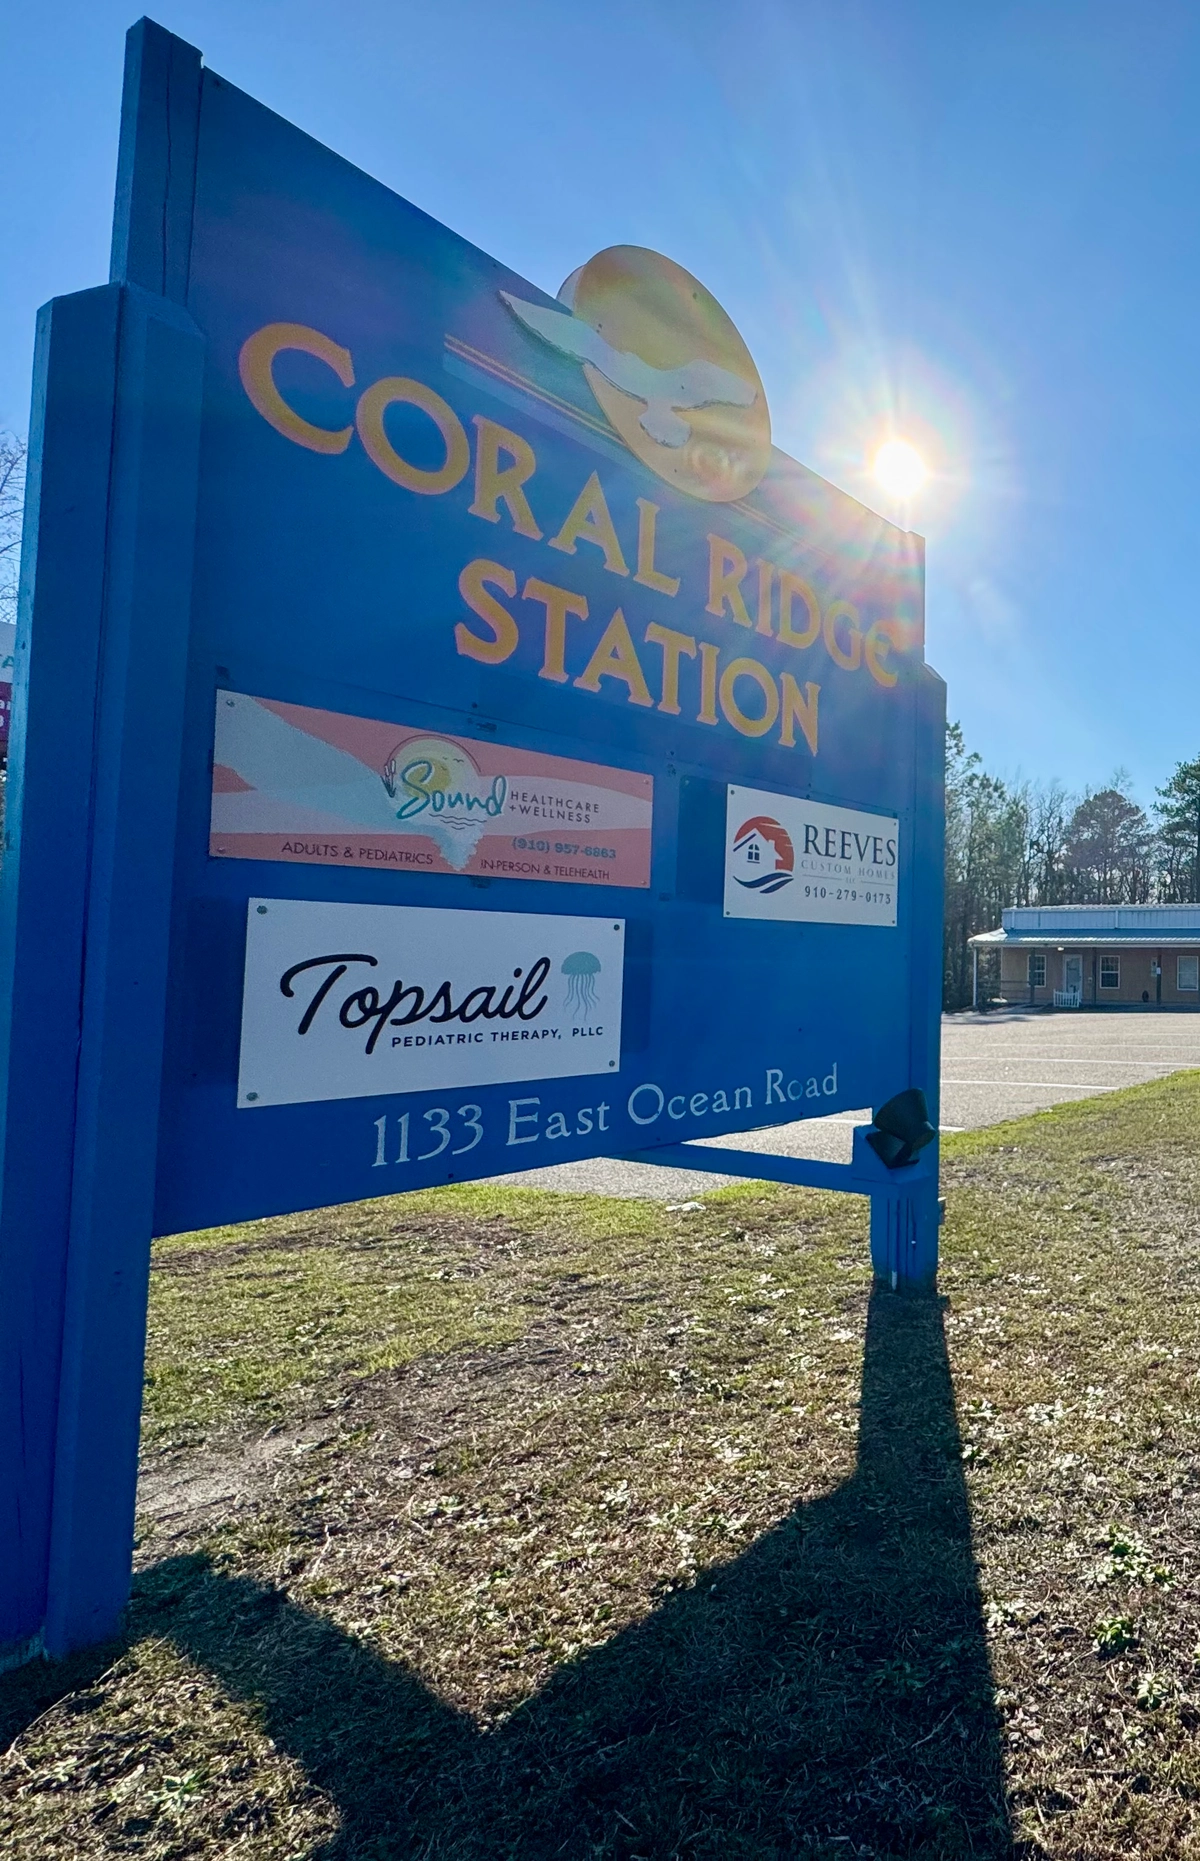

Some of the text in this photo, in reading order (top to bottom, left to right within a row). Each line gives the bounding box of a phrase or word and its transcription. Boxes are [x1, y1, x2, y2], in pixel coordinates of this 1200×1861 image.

[240, 322, 900, 689] CORAL RIDGE
[455, 559, 821, 756] STATION
[396, 760, 506, 820] Sound
[510, 790, 600, 814] HEALTHCARE
[281, 841, 434, 865] ADULTS & PEDIATRICS
[512, 836, 617, 859] (910) 957-6863
[803, 823, 897, 867] REEVES
[480, 859, 610, 880] IN-PERSON & TELEHEALTH
[801, 859, 896, 880] CUSTOM HOMES
[804, 885, 891, 904] 910-279-0173
[279, 953, 551, 1055] Topsail
[391, 1026, 603, 1048] PEDIATRIC THERAPY, PLLC
[372, 1062, 839, 1168] 1133 East Ocean Road
